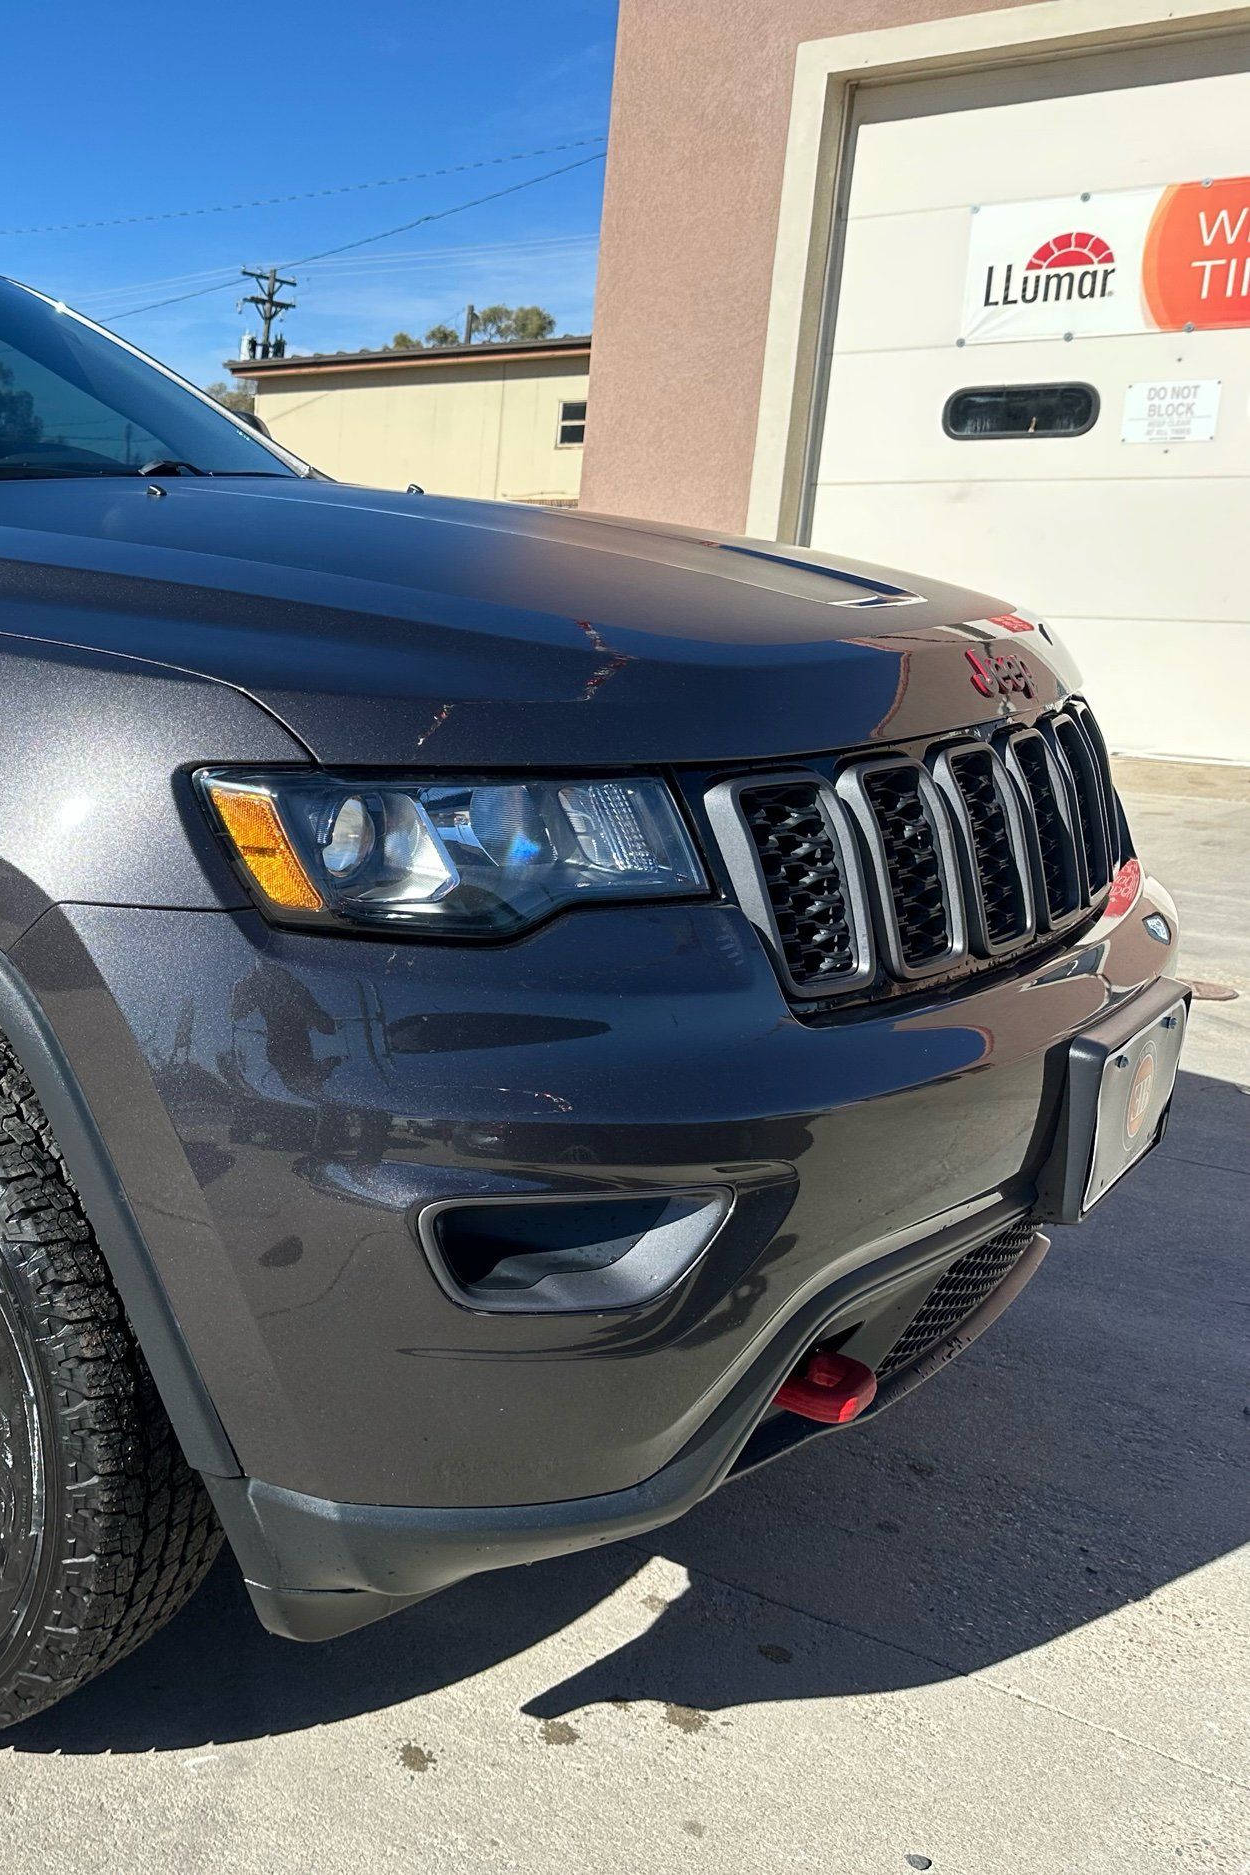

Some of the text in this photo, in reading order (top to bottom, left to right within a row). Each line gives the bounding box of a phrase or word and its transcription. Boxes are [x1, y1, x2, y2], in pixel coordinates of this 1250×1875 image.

[1198, 206, 1250, 247] W
[983, 264, 1116, 307] LLumar
[1191, 257, 1250, 300] TI
[1147, 384, 1201, 401] DO NOT
[1147, 402, 1196, 418] BLOCK
[964, 648, 1039, 700] Jeep
